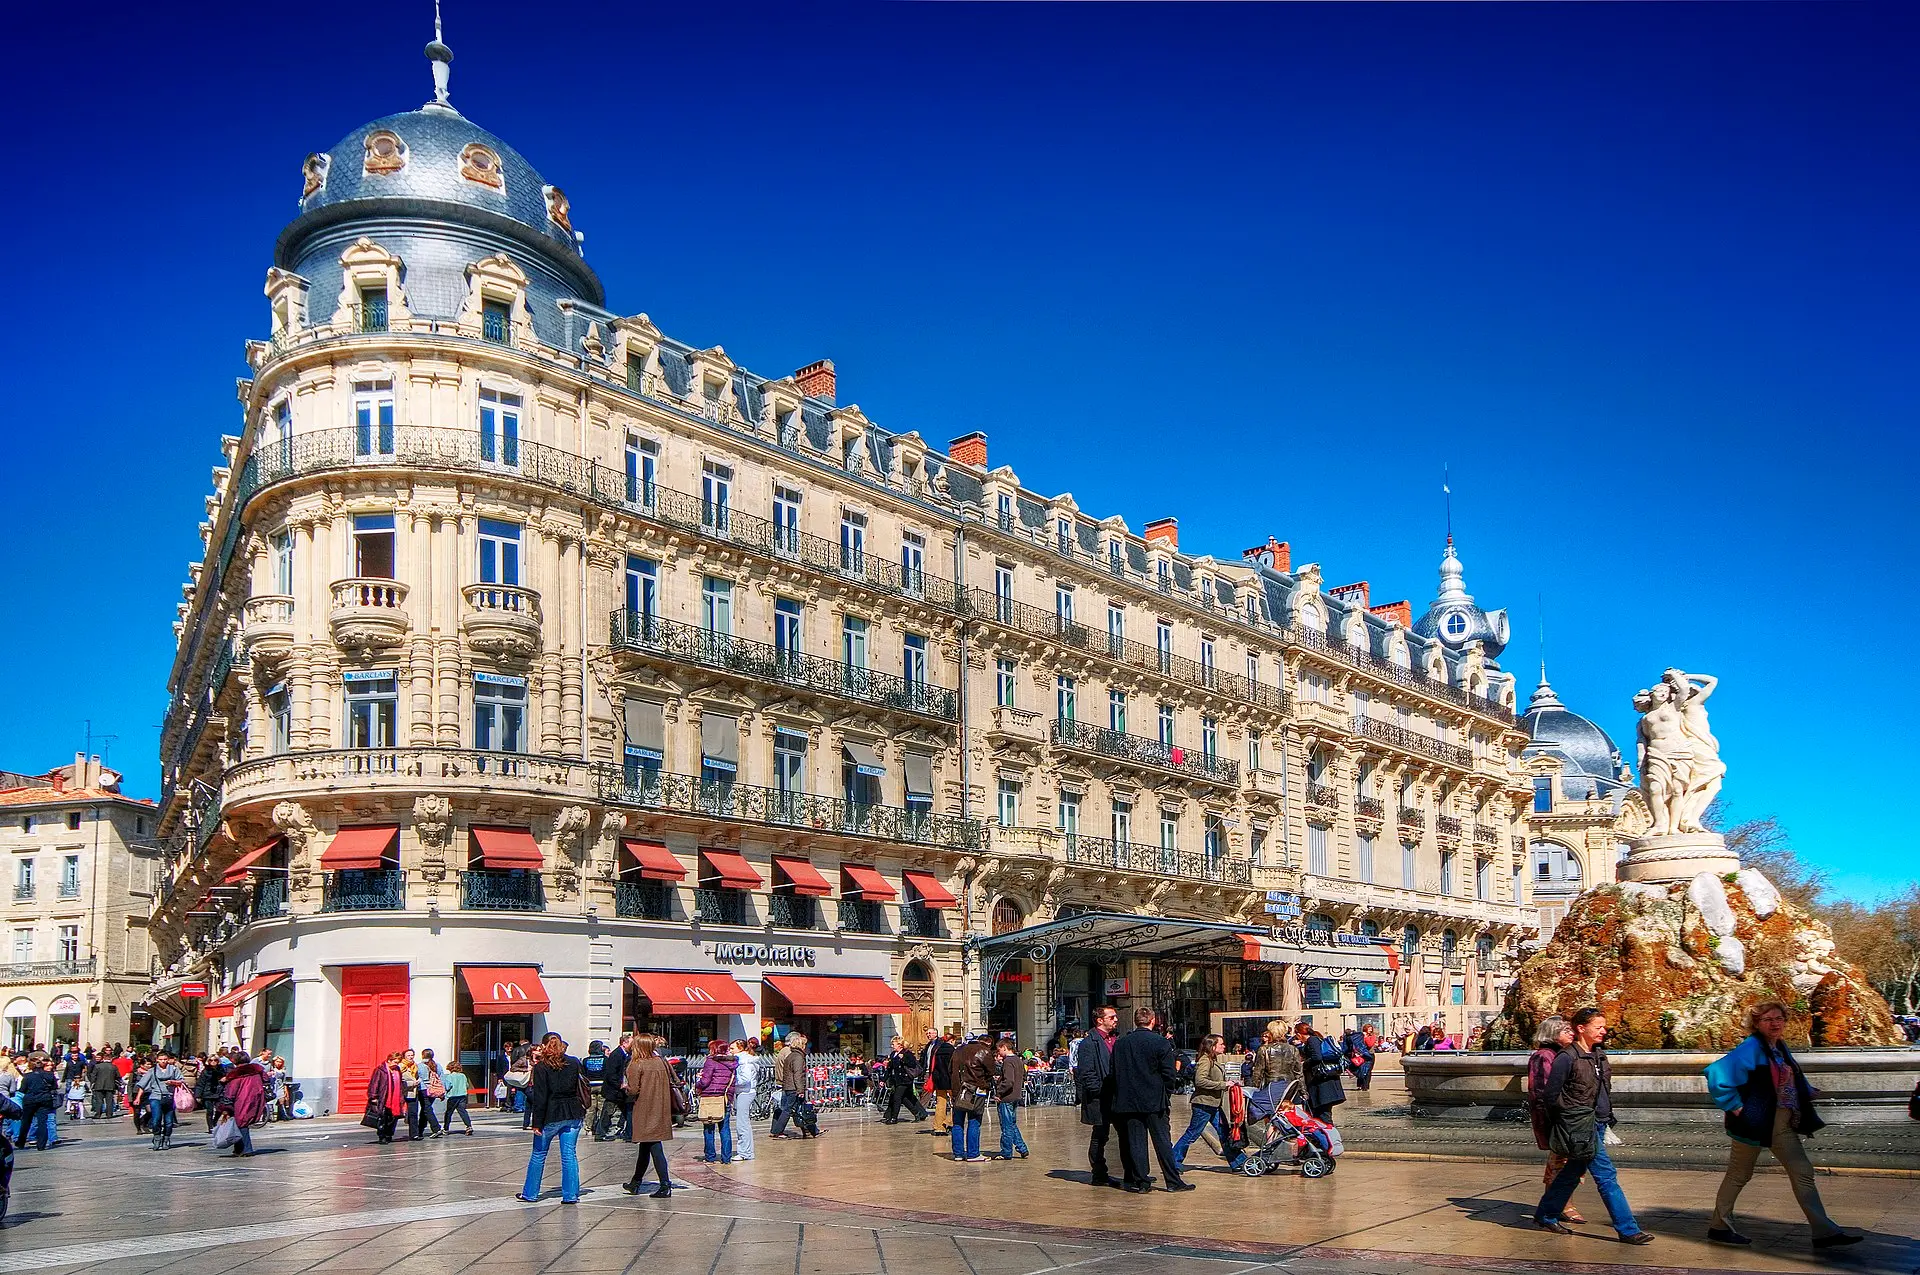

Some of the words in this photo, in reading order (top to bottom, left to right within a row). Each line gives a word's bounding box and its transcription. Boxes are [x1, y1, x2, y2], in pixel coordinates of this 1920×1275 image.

[353, 670, 392, 680] BARCLAYS
[486, 675, 524, 685] BARCLAYS
[1285, 926, 1308, 944] Café
[1310, 929, 1329, 942] 1893
[716, 943, 816, 961] McDonald's
